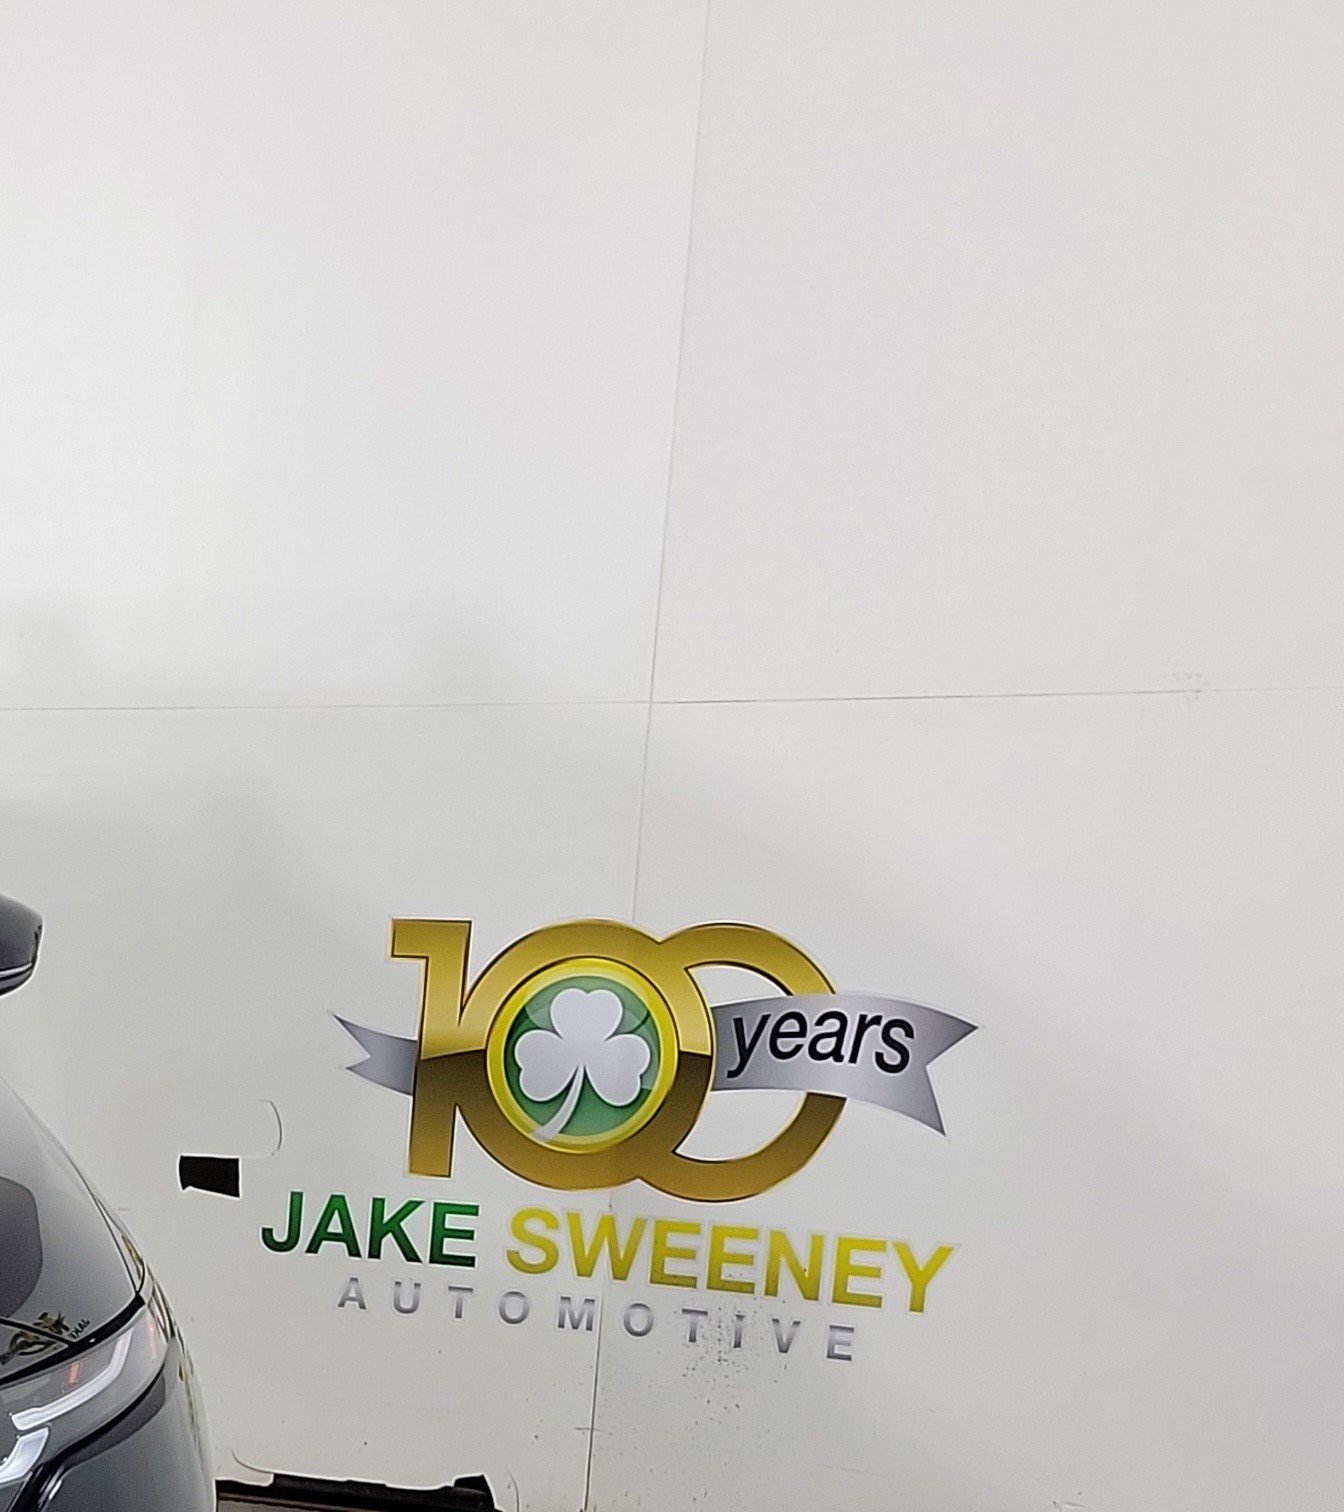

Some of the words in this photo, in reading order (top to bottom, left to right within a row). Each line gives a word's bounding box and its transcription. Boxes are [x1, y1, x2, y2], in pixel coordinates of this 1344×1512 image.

[389, 917, 848, 1203] 100
[724, 1007, 915, 1078] years
[260, 1191, 480, 1267] JAKE
[506, 1207, 954, 1314] SWEENEY
[336, 1276, 857, 1362] AUTOMOTIVE
